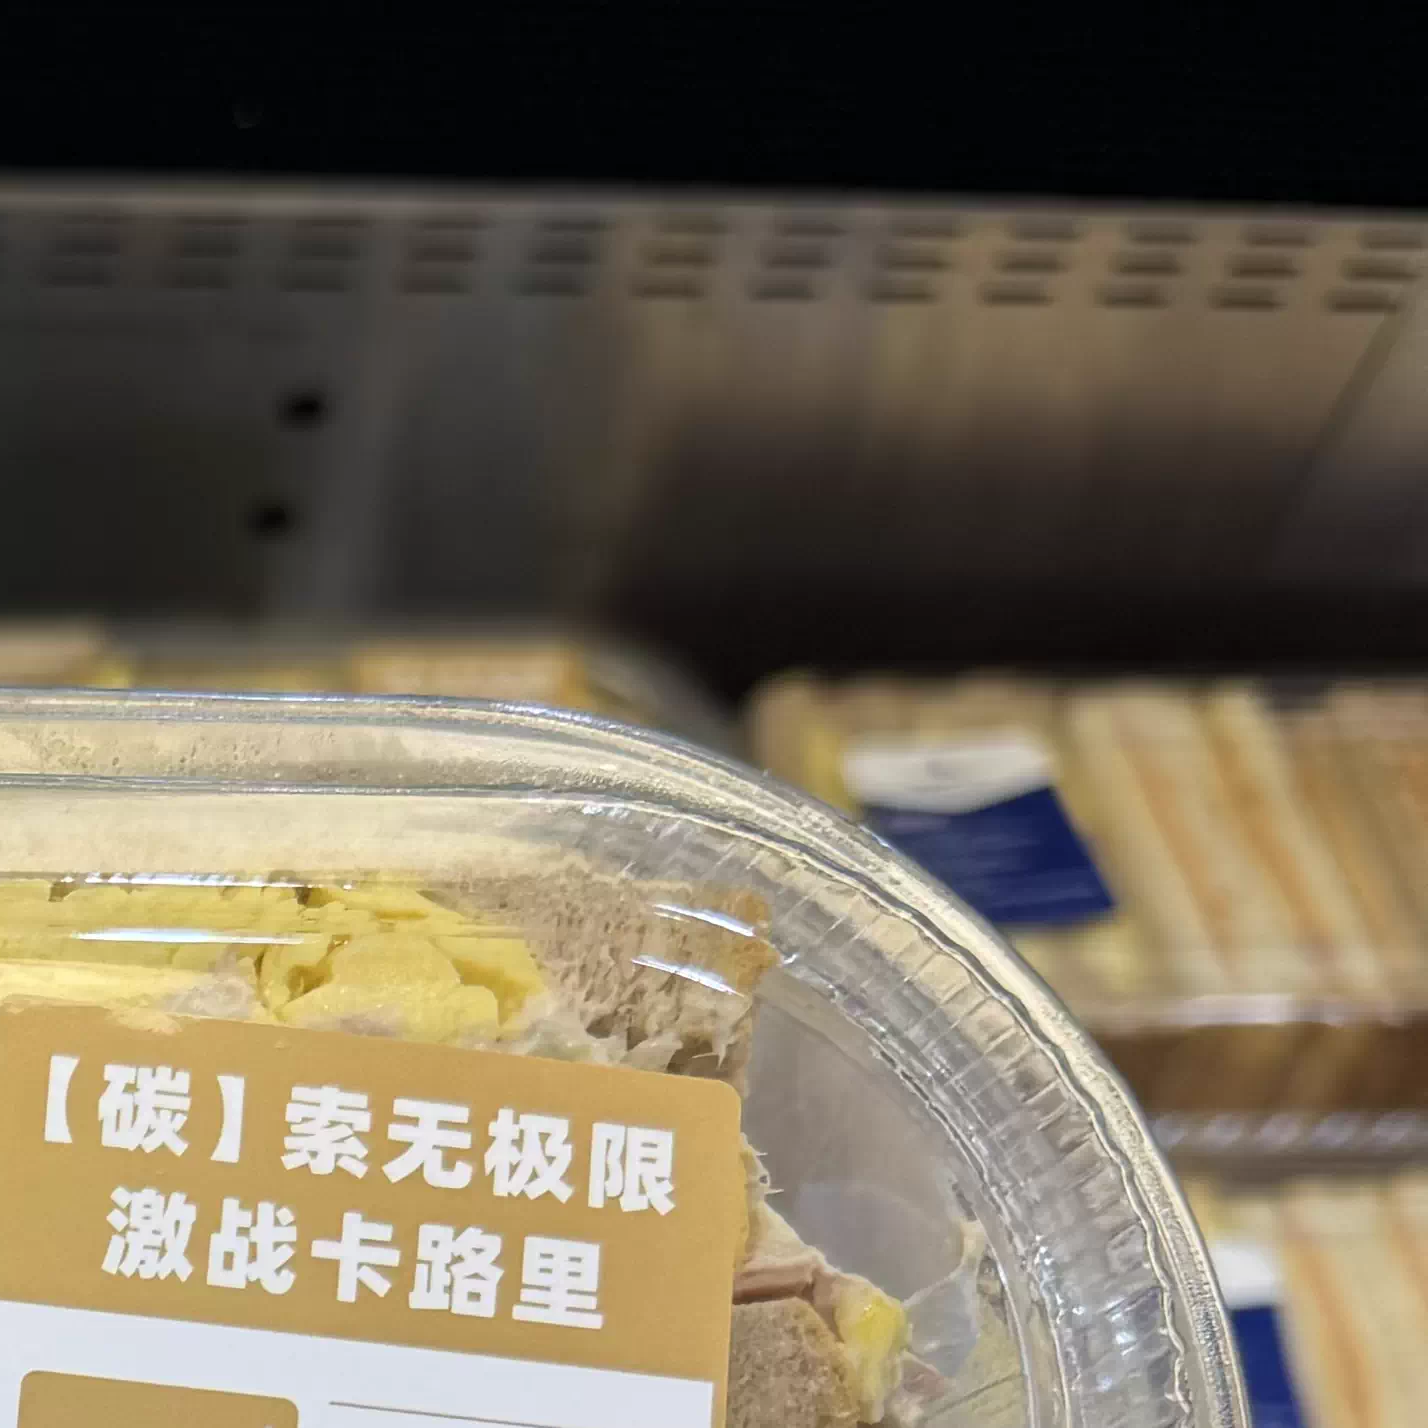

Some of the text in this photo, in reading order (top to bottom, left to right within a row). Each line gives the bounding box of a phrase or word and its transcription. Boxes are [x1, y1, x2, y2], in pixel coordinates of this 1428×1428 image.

[40, 1055, 677, 1216] 【碳】索无极限
[101, 1186, 606, 1331] 激战卡路里
